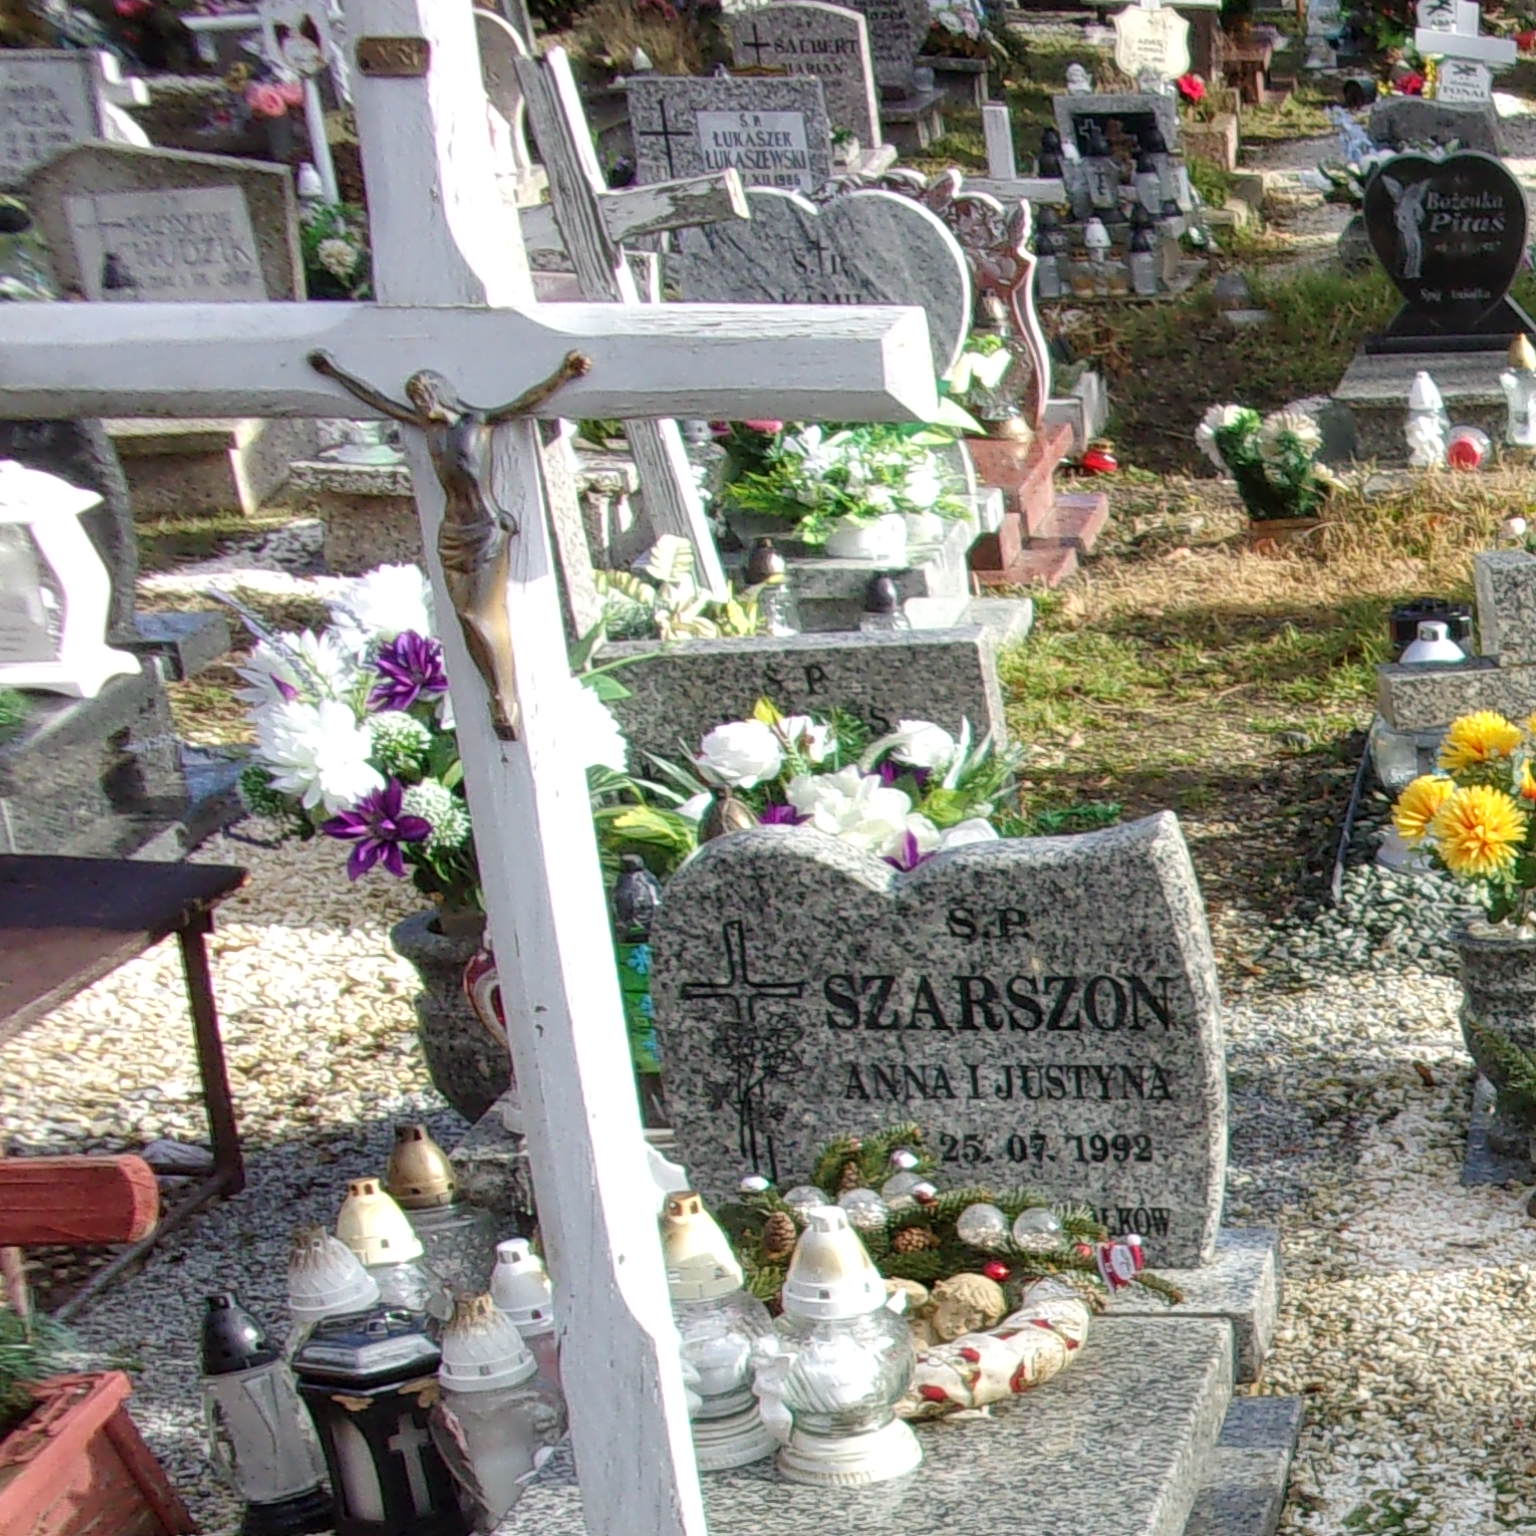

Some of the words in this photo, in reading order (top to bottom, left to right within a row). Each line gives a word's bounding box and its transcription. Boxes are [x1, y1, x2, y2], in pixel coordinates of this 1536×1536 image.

[713, 131, 793, 148] ŁUKASZEK
[705, 150, 806, 170] ŁUKASZEWSKI
[823, 972, 1182, 1032] SZARSZON
[845, 1064, 956, 1100] ANNA
[967, 1064, 982, 1100] I
[995, 1064, 1173, 1100] JUSTYNA
[1066, 1133, 1154, 1163] 1992
